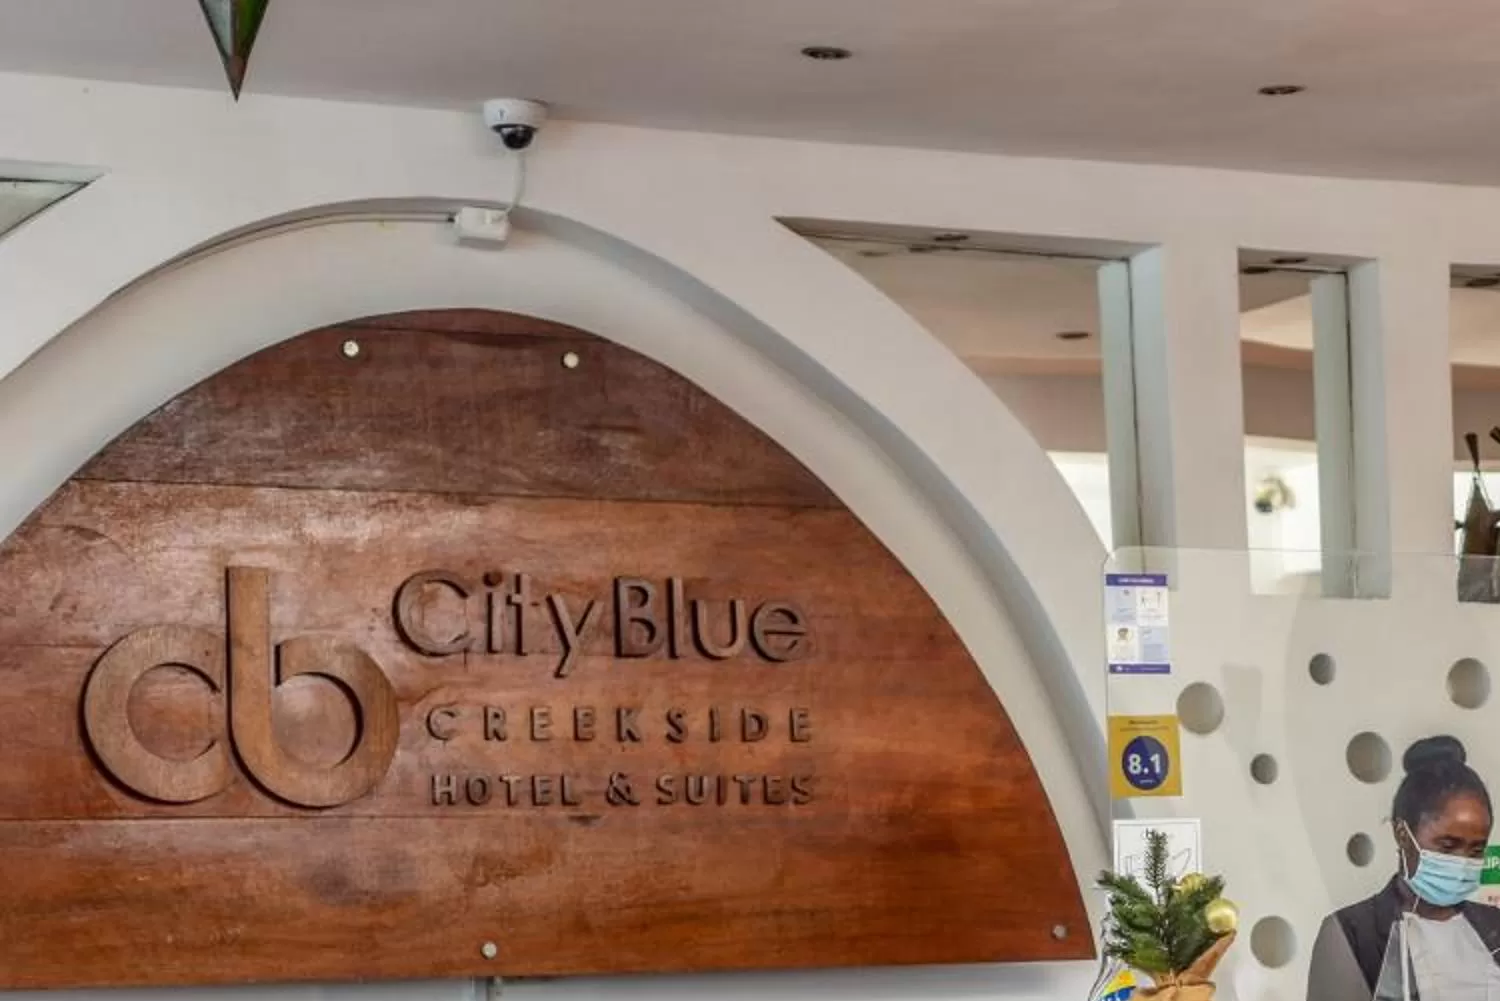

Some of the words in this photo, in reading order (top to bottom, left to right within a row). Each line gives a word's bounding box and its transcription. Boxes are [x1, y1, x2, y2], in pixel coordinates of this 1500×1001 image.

[427, 706, 812, 743] CREEKSIDE
[1128, 753, 1161, 775] 8.1
[431, 773, 579, 806] HOTEL
[605, 771, 641, 807] &
[656, 773, 813, 807] SUITES
